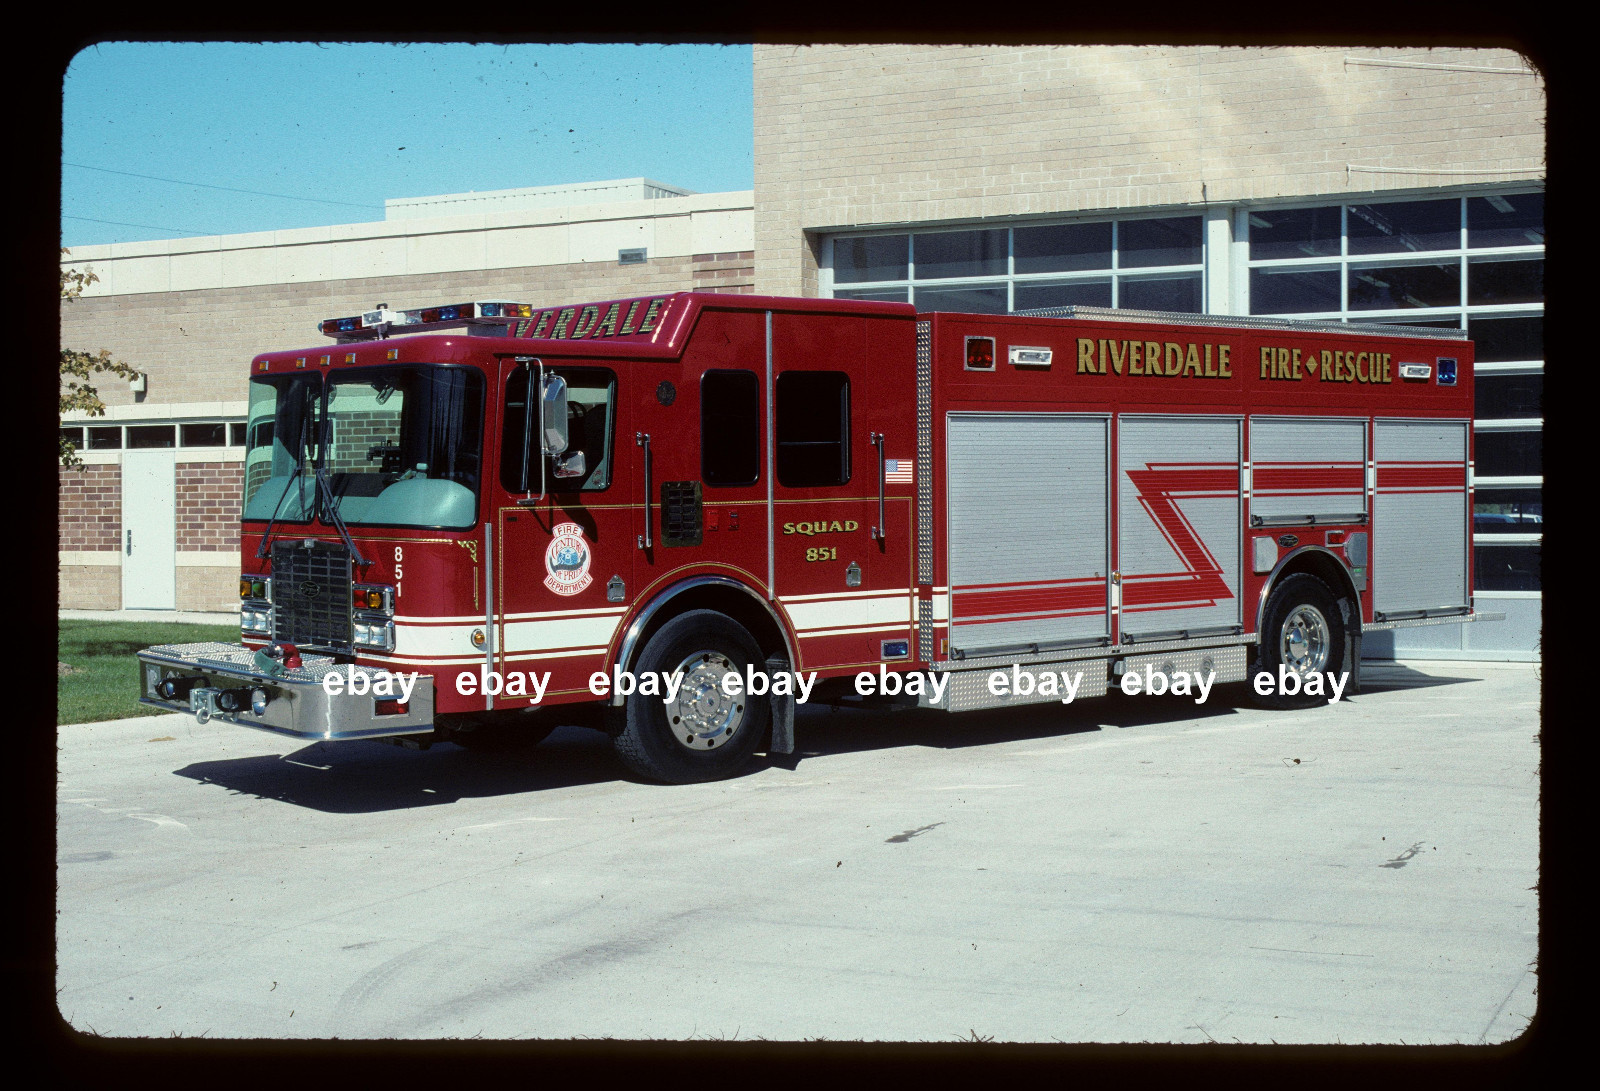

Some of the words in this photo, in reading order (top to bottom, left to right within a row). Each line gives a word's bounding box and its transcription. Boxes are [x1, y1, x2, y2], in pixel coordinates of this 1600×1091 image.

[506, 298, 665, 340] VERDALE
[1076, 337, 1233, 379] RIVERDALE
[1260, 346, 1303, 381] FIRE
[1320, 349, 1393, 384] RESCUE
[557, 525, 580, 535] FIRE
[783, 520, 859, 536] SQUAD
[805, 546, 837, 562] 851
[548, 576, 590, 592] DEPARTMENT
